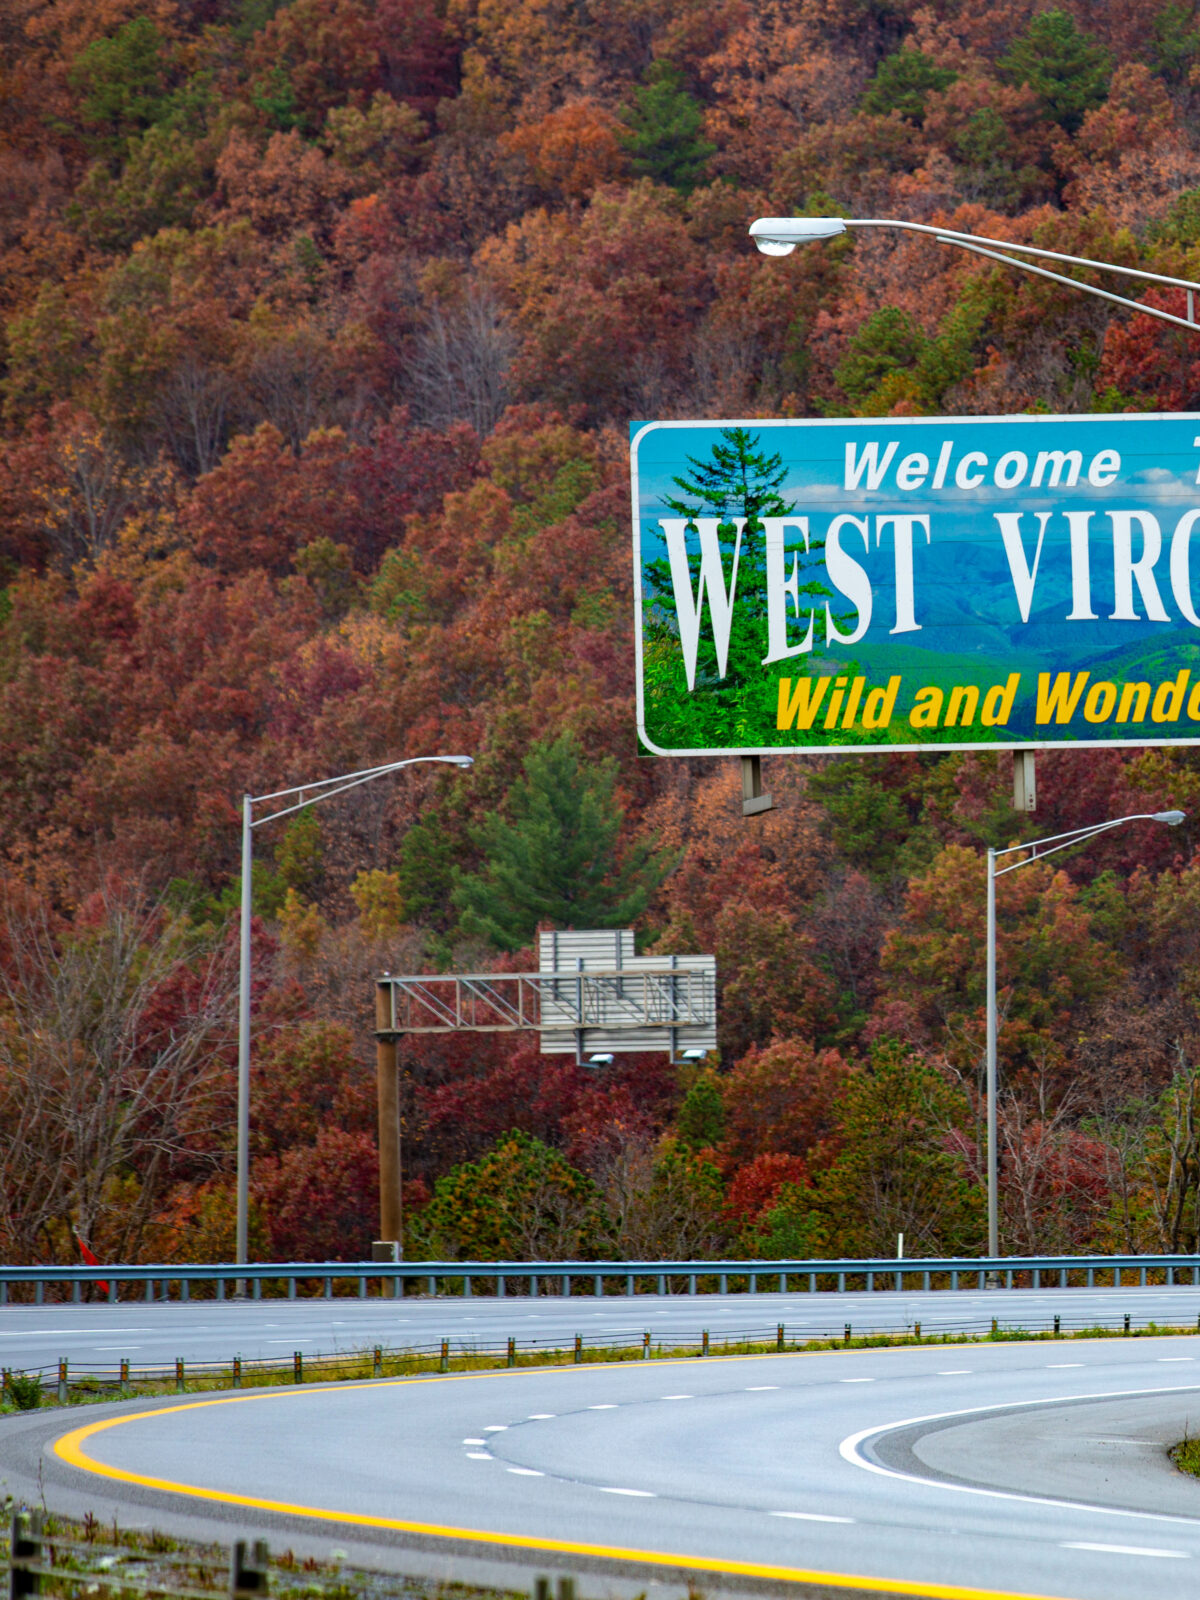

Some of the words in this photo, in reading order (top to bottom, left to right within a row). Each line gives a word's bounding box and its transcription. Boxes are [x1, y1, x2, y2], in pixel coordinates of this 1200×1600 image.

[844, 440, 1121, 491] Welcome
[658, 513, 931, 691] WEST
[776, 675, 902, 731] Wild
[909, 672, 1021, 728] and
